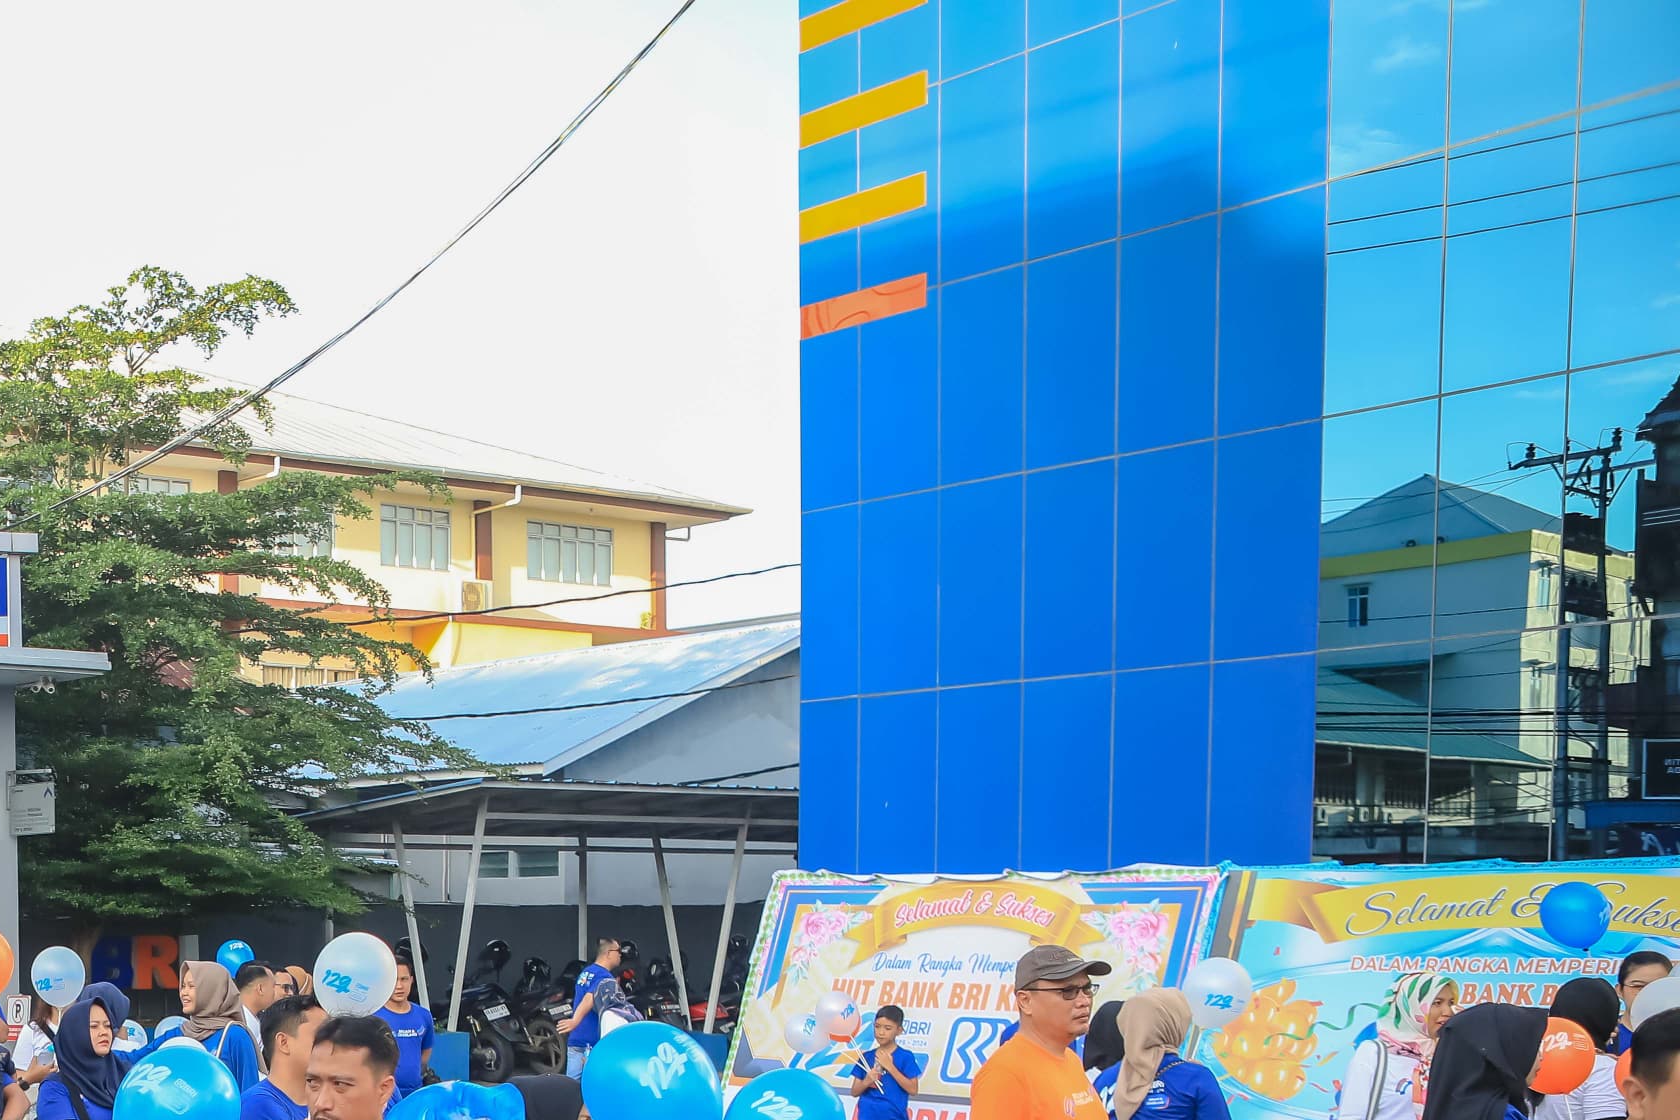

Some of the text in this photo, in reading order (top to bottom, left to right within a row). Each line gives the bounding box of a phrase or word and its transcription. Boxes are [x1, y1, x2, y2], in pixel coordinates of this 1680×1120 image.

[895, 889, 1056, 928] Selamat & Sukses
[1346, 888, 1508, 936] Selamat
[872, 951, 1019, 978] Dalam Rangka Mempe
[1350, 956, 1619, 975] DALAM RANGKA MEMPERI
[35, 978, 53, 992] 129
[321, 969, 353, 994] 129
[878, 980, 944, 1009] BANK
[947, 982, 992, 1011] BRI
[1204, 994, 1234, 1010] 129
[1460, 983, 1537, 1007] BANK
[909, 1020, 932, 1036] BRI
